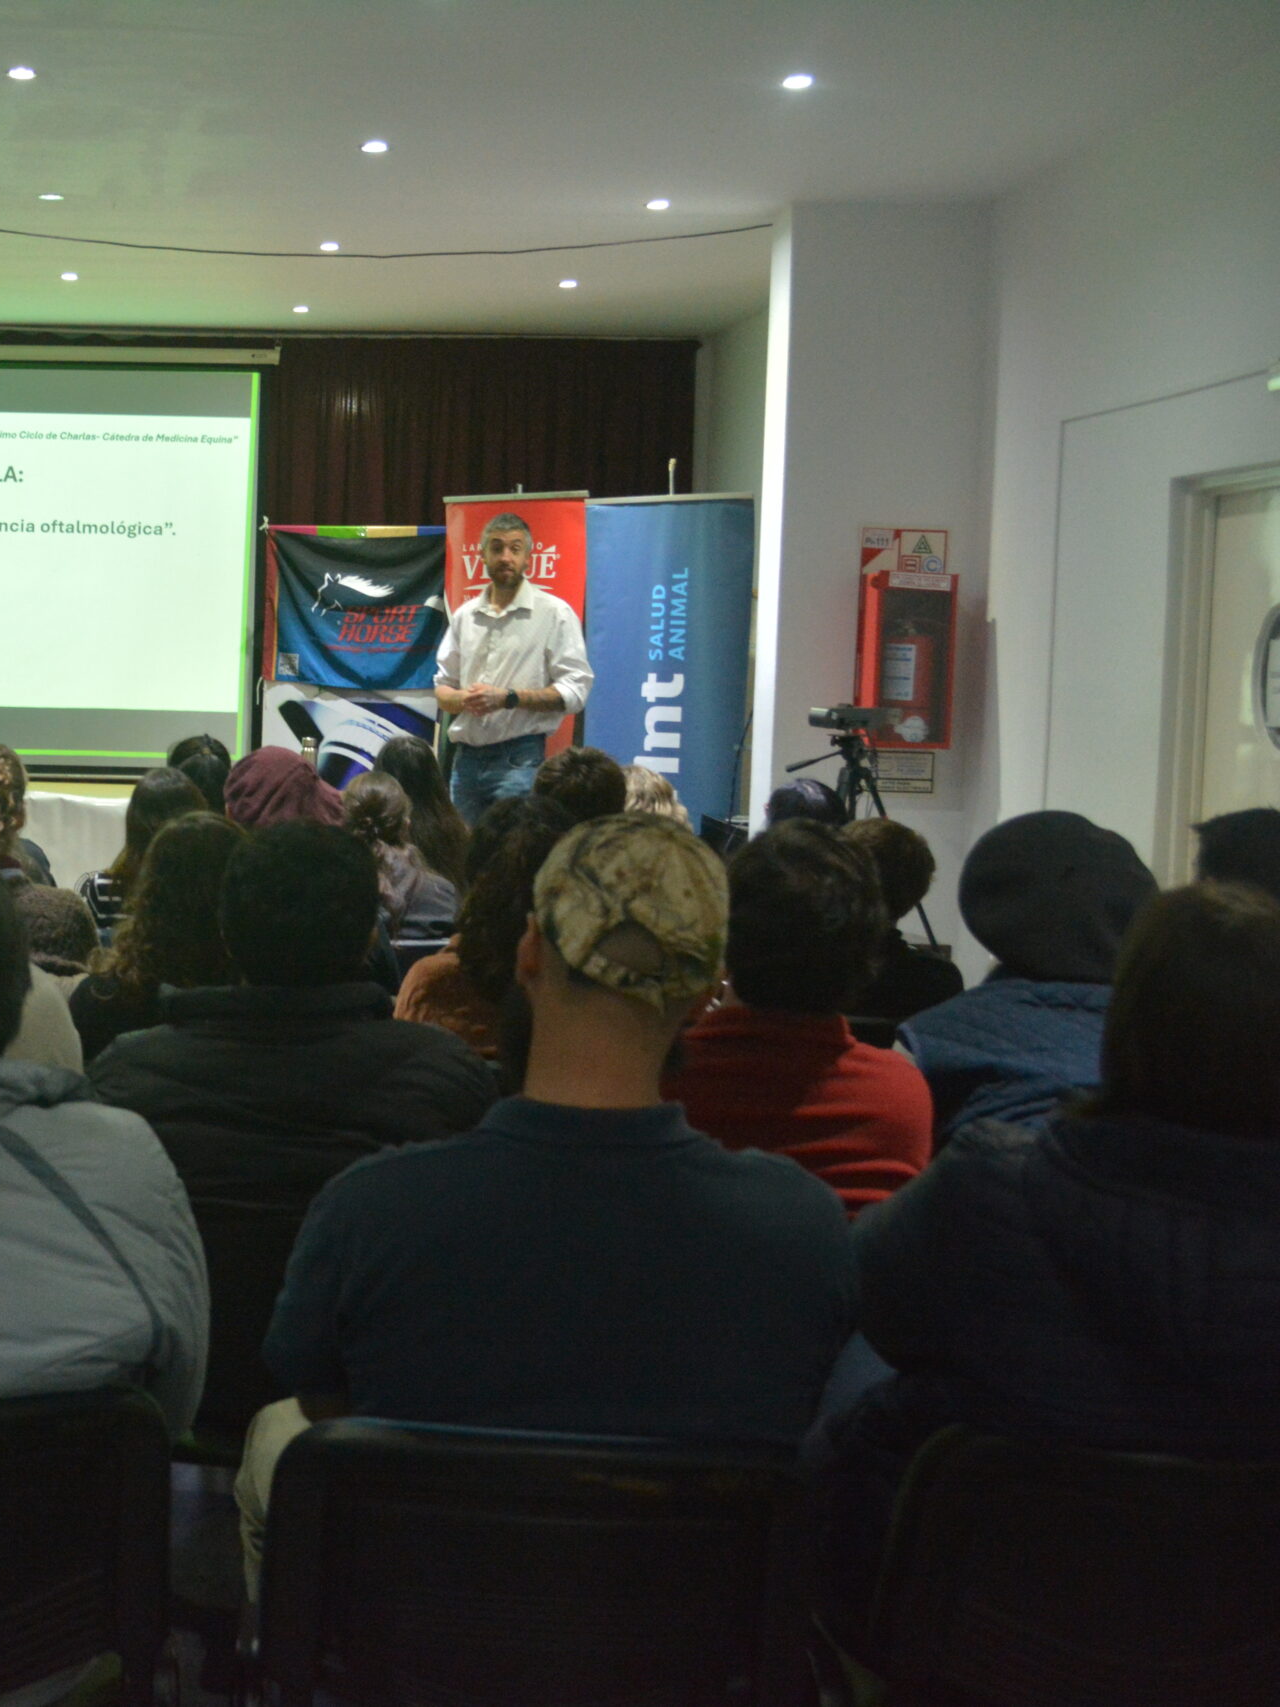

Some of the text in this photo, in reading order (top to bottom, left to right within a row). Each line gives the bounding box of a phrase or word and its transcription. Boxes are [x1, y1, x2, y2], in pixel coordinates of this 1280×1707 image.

[19, 431, 43, 439] Ciclo
[46, 431, 57, 440] de
[60, 432, 100, 441] Charlas-
[102, 432, 140, 441] Cátedra
[142, 433, 154, 442] de
[156, 434, 198, 443] Medicina
[338, 624, 416, 643] HORSE
[649, 584, 666, 661] SALUD
[669, 568, 689, 661] ANIMAL
